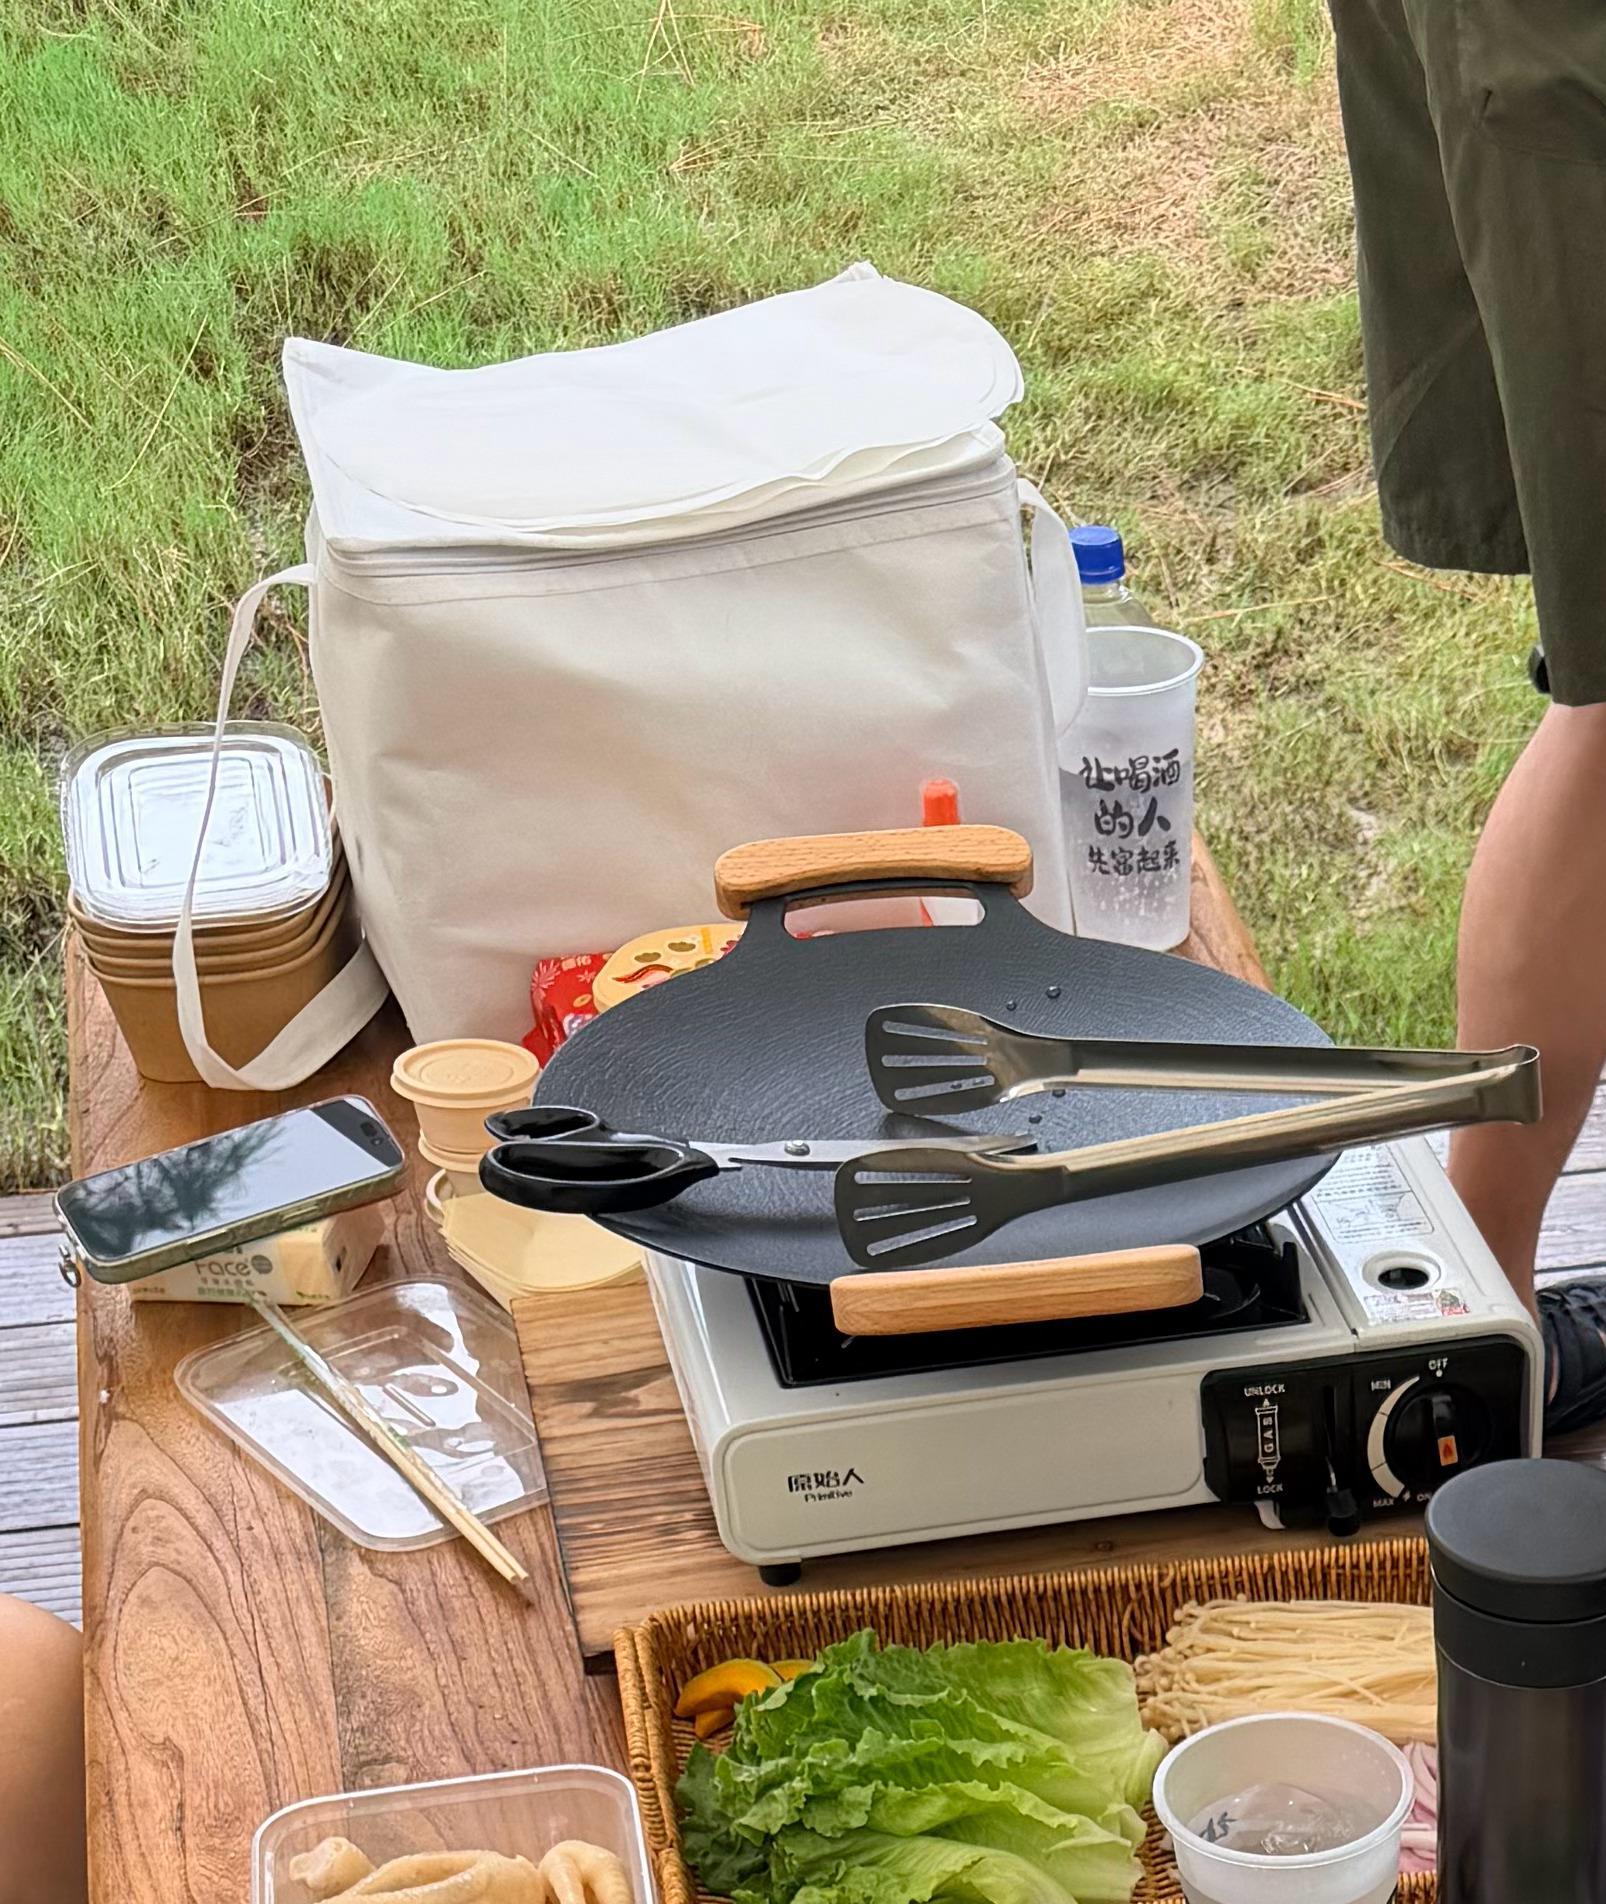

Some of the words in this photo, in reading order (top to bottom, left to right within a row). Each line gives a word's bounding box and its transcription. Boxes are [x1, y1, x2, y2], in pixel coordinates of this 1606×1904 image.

[1079, 748, 1180, 793] 让喝酒
[1094, 796, 1171, 839] 的人
[1428, 1358, 1448, 1370] OFF
[1244, 1384, 1286, 1397] UNLOCK
[1257, 1484, 1283, 1494] LOCK
